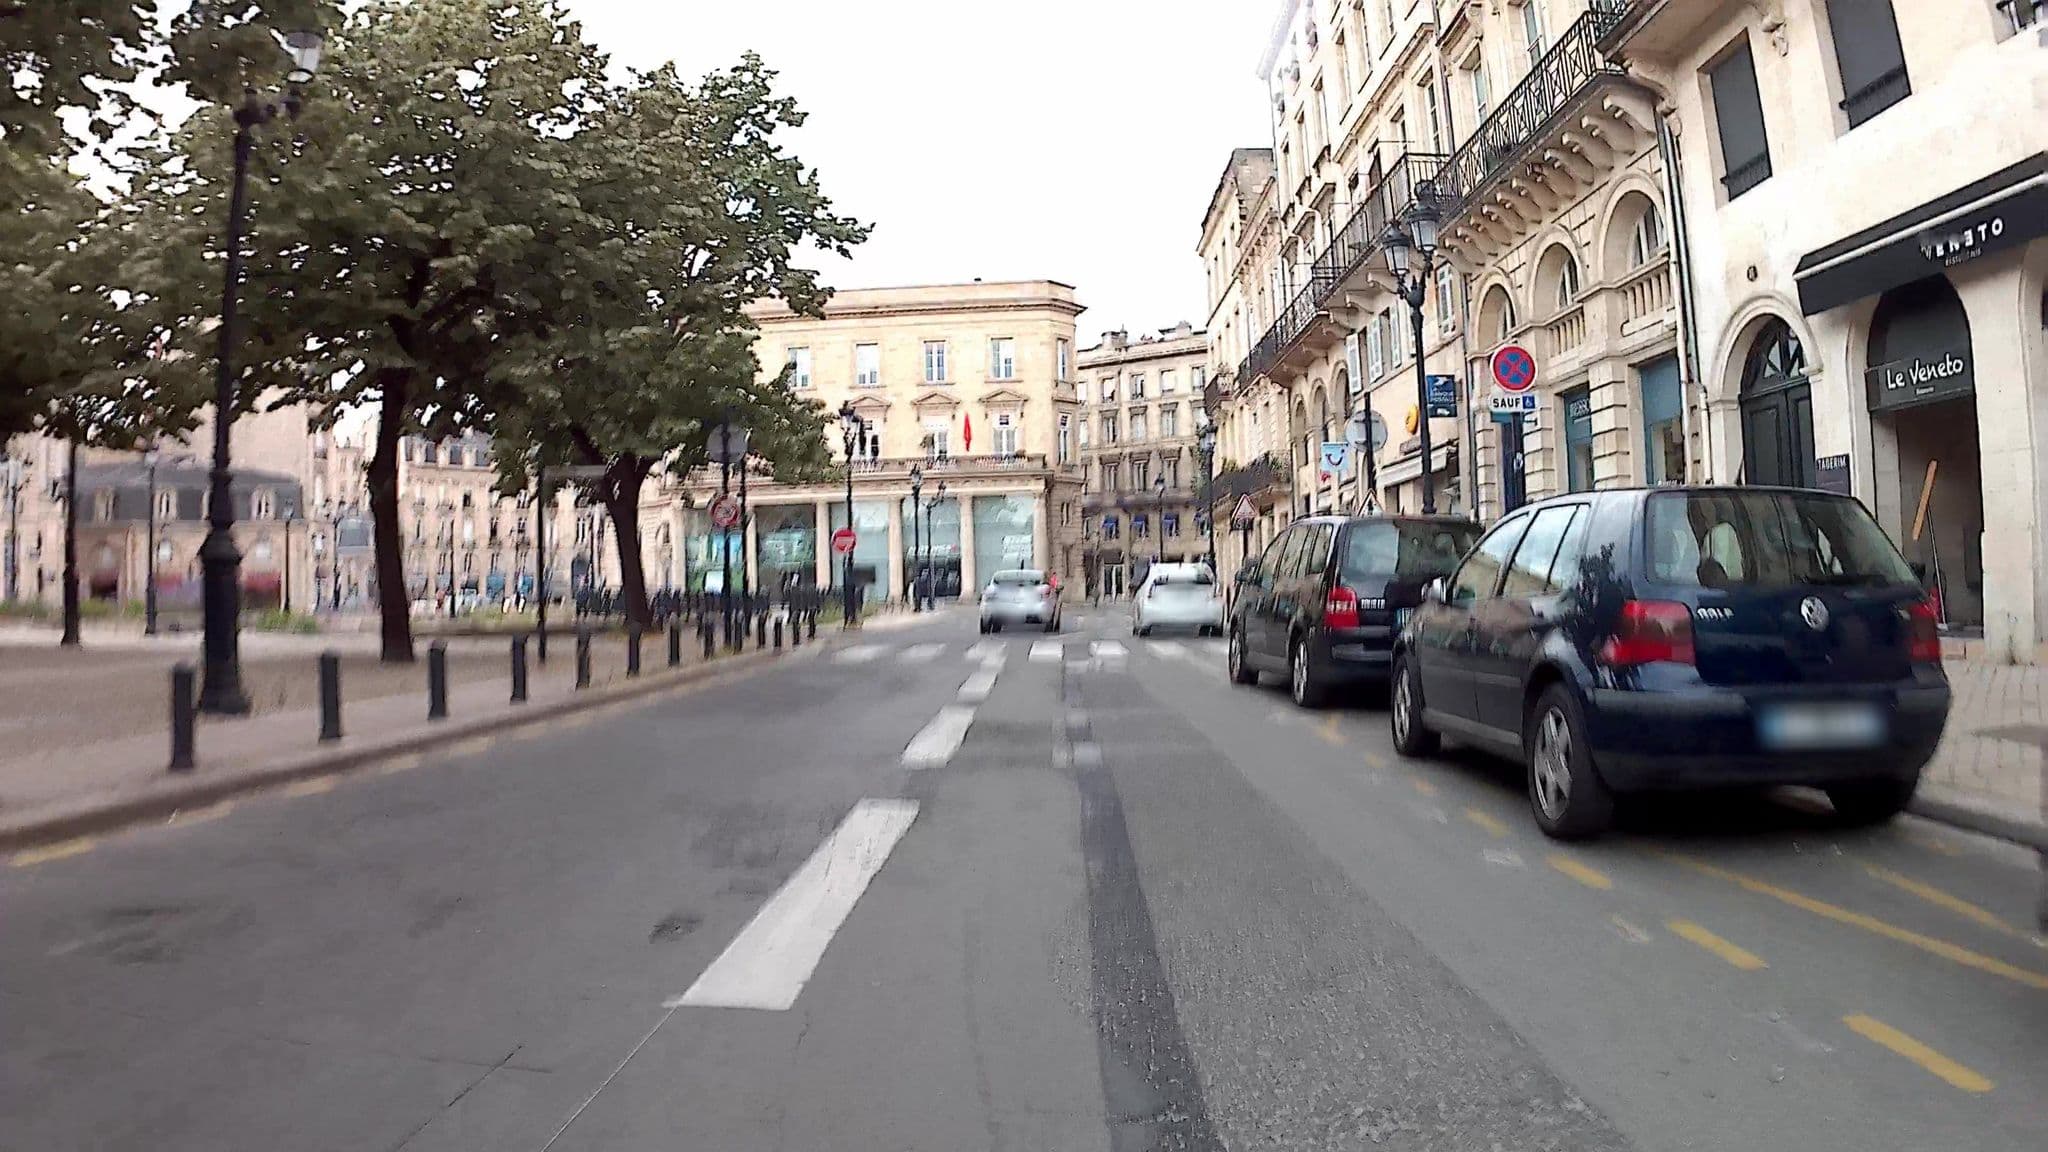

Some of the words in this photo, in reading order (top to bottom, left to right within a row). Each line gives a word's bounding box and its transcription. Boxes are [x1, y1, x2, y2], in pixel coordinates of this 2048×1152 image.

[1886, 369, 1906, 390] Le
[1908, 352, 1964, 385] Veneto
[1492, 397, 1521, 409] SAUF
